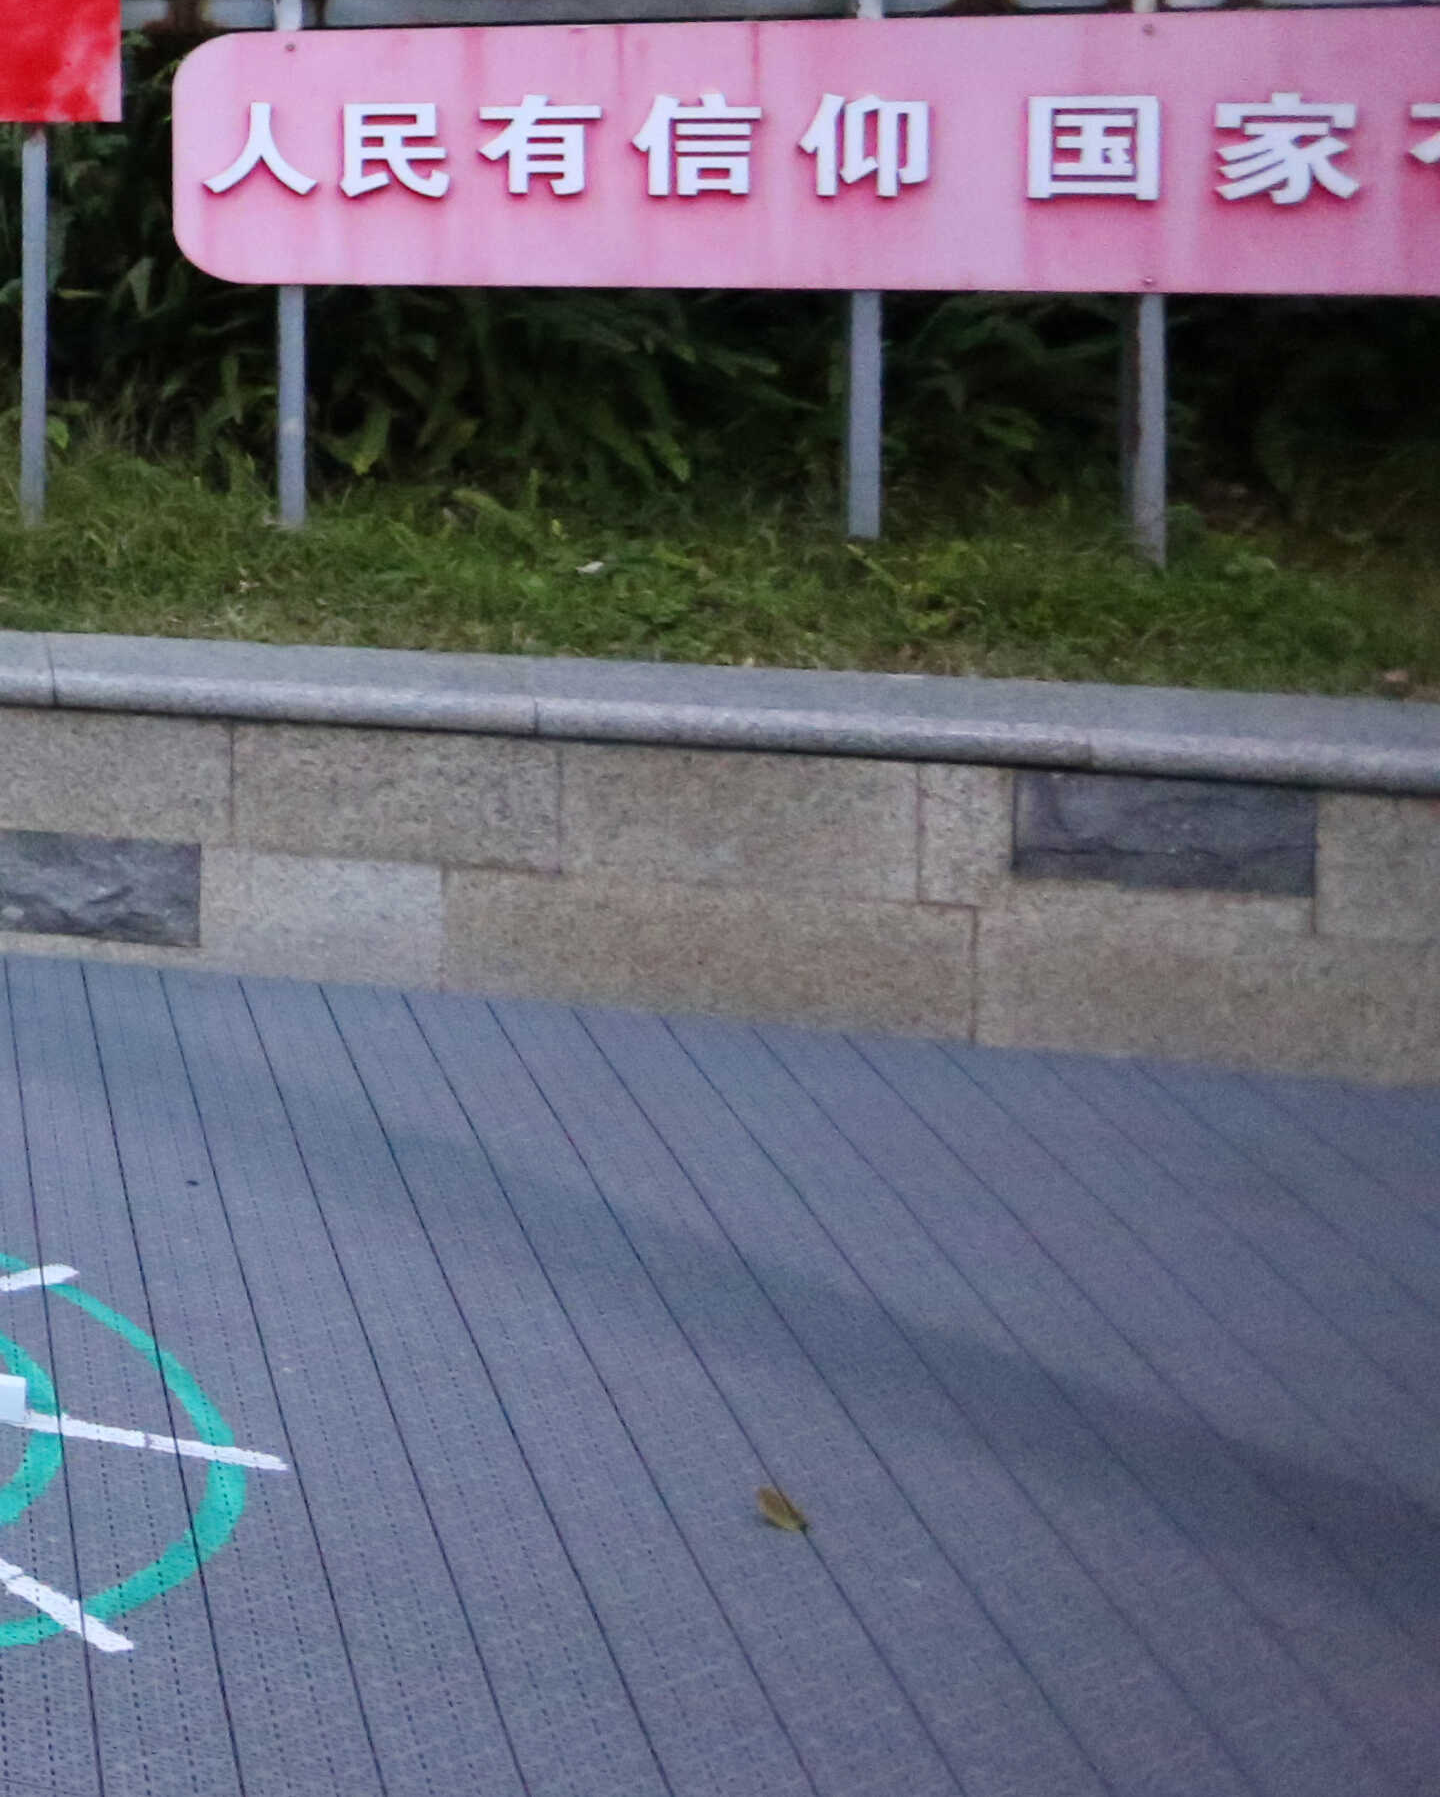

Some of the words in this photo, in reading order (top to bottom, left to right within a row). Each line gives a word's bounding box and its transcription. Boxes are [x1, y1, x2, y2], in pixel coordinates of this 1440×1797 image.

[205, 92, 930, 197] 人民有信仰
